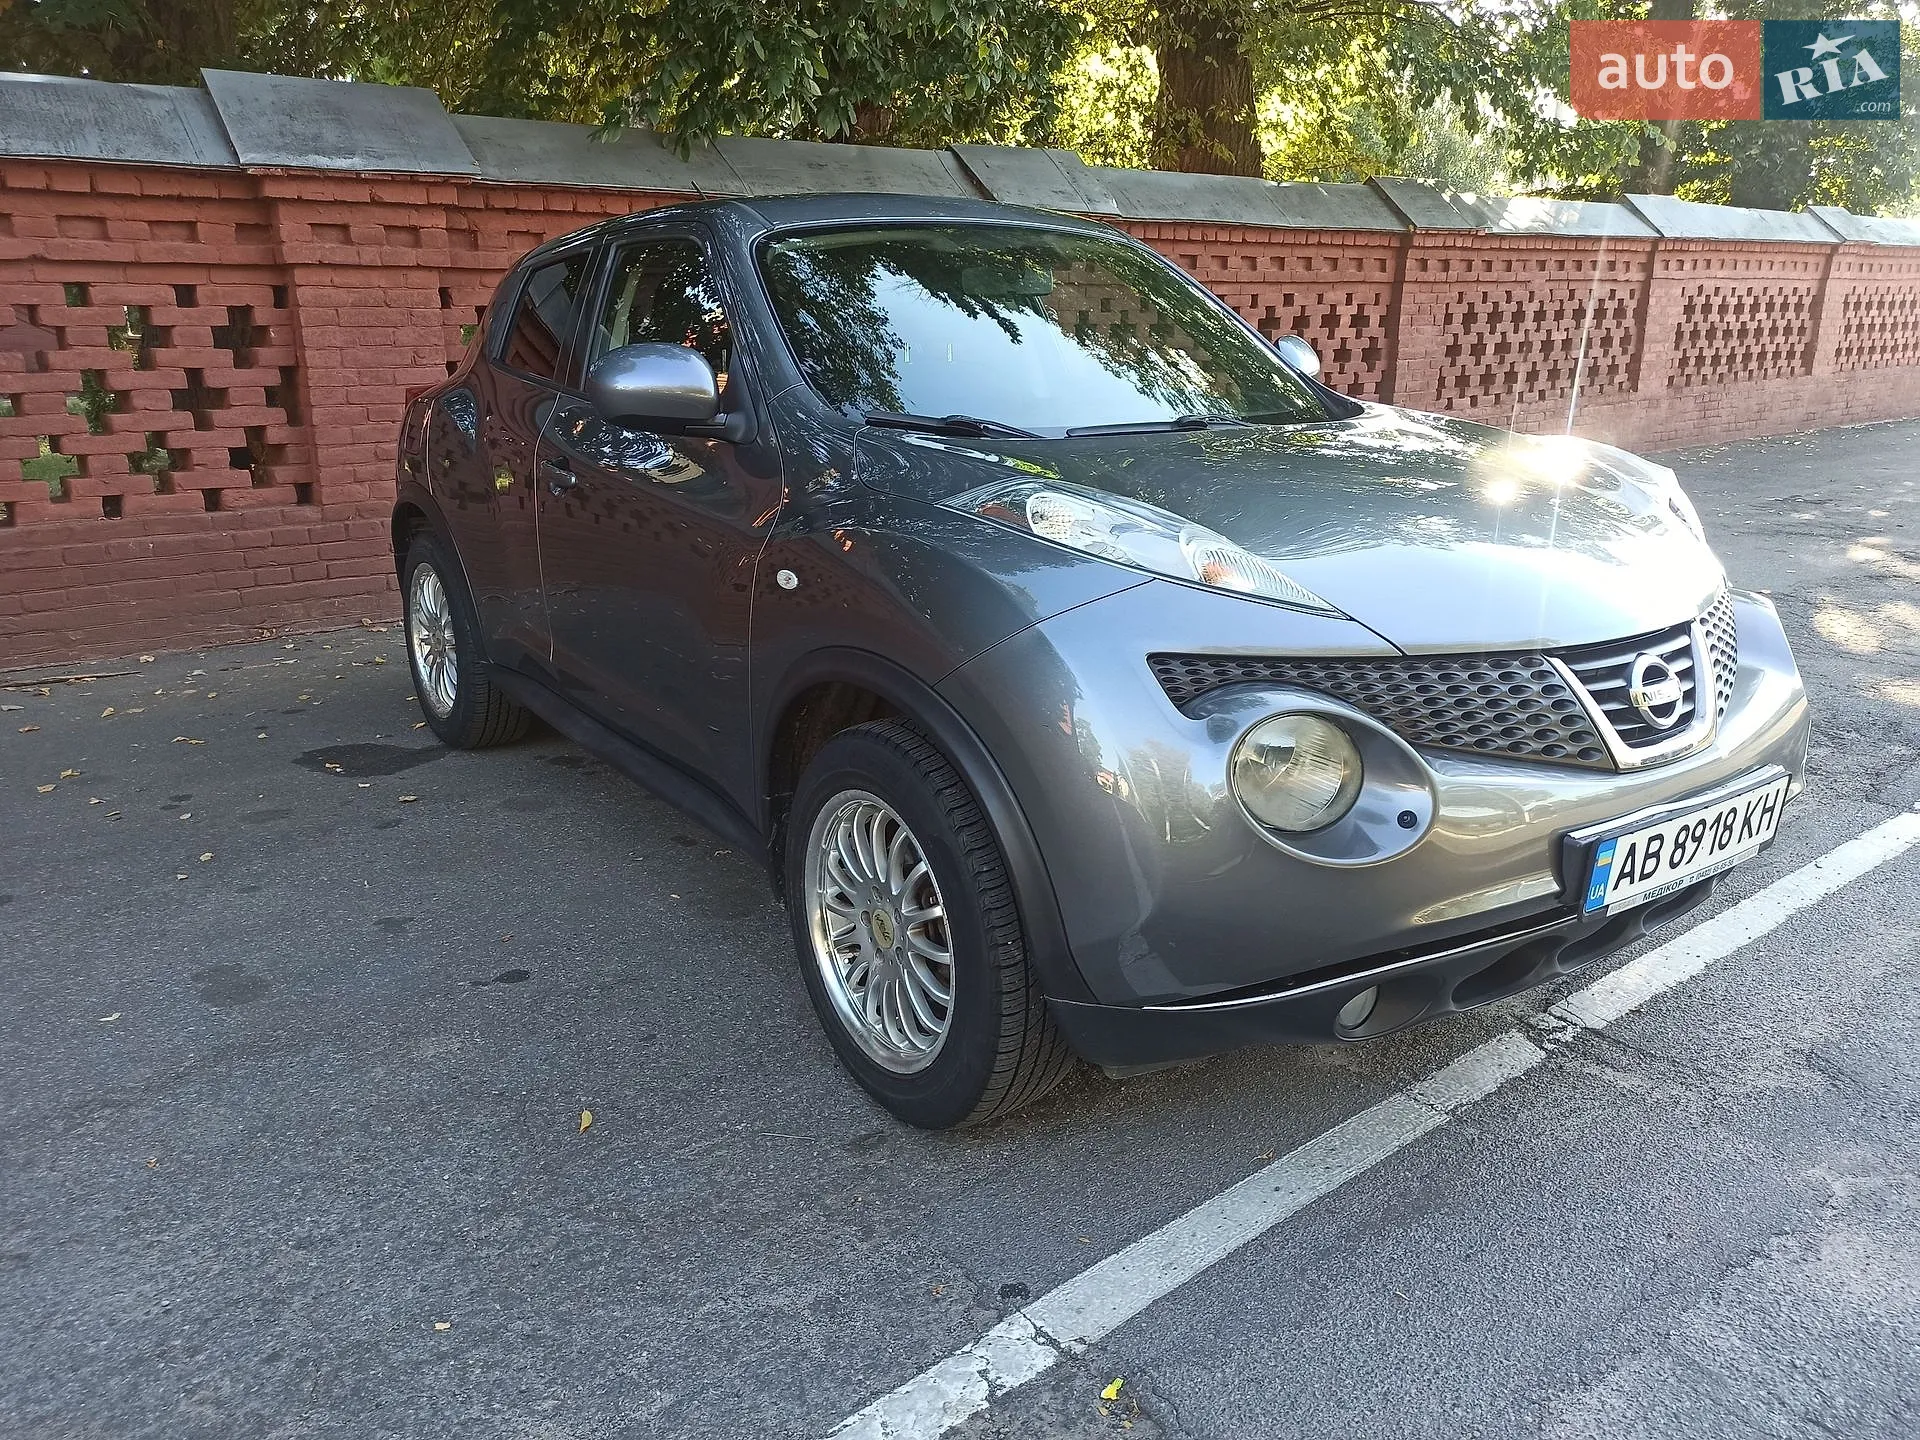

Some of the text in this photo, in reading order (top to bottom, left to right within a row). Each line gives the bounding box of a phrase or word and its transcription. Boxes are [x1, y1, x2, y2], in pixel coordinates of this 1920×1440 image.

[1612, 788, 1781, 891] AB 8918 KH
[1590, 885, 1605, 900] UA
[1642, 879, 1684, 901] МЕДІКОР
